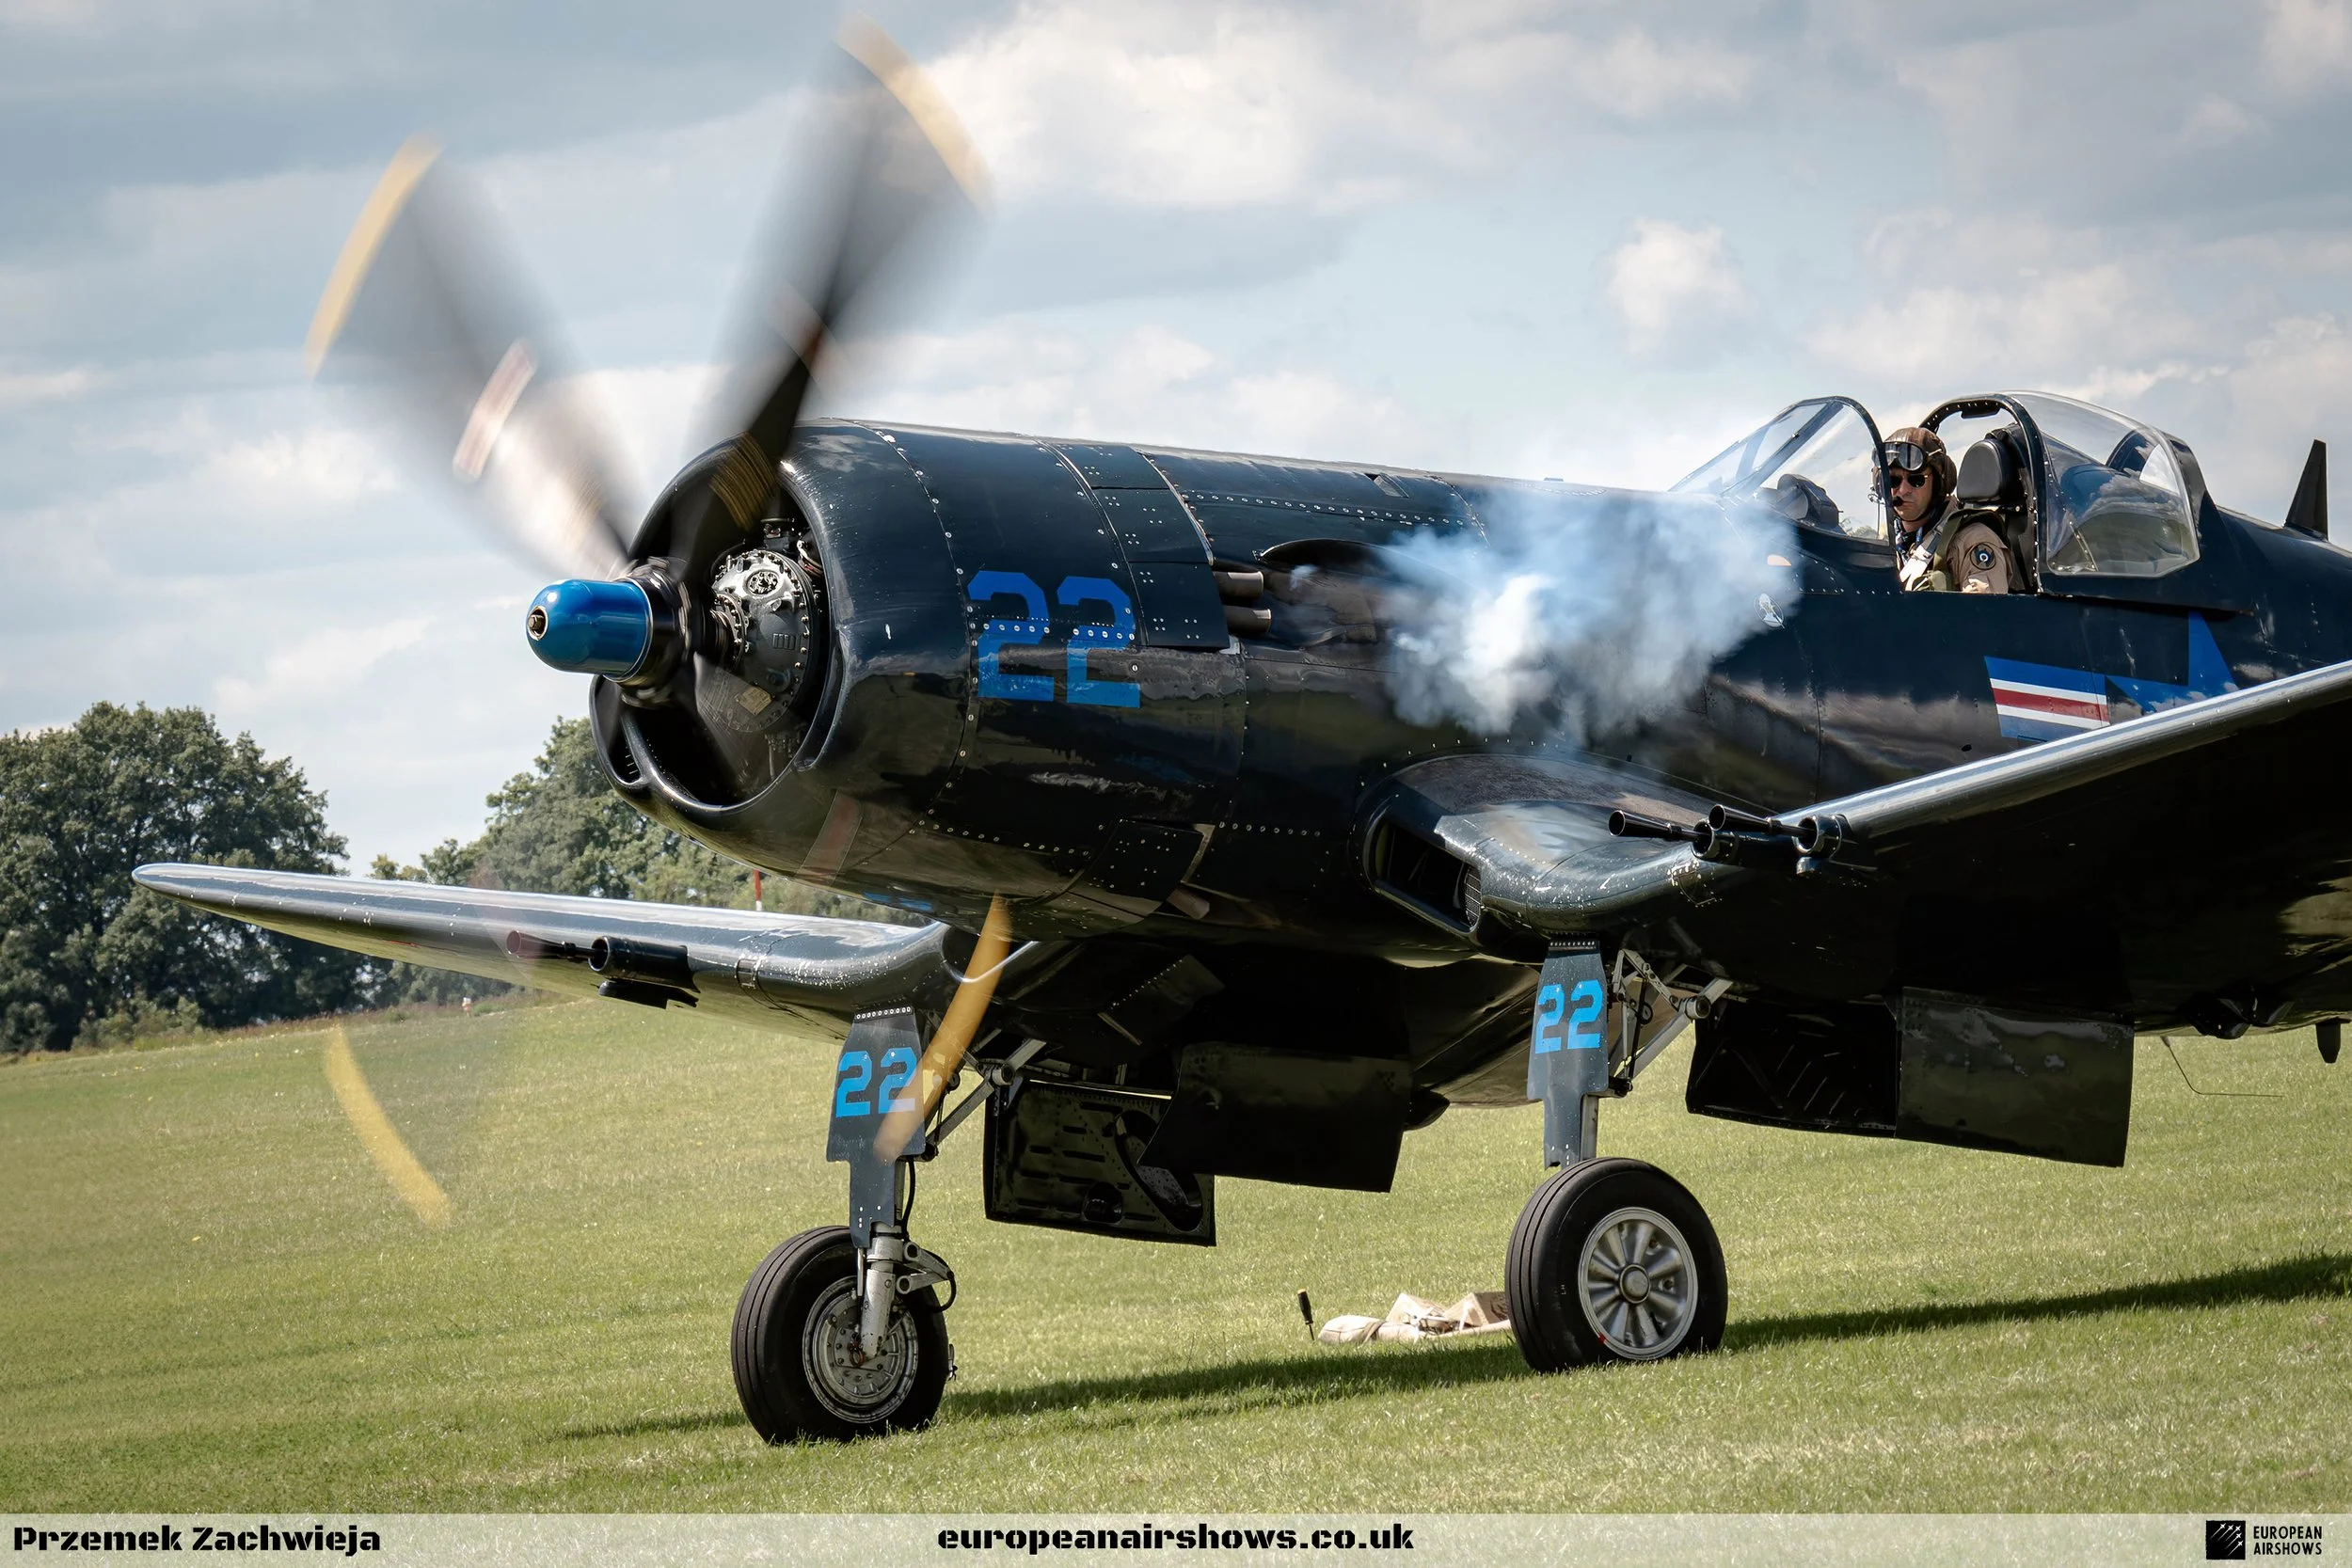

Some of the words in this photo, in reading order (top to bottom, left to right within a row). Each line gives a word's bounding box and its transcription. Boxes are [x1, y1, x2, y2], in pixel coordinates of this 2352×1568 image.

[967, 570, 1141, 708] 22
[1535, 979, 1604, 1054] 22
[835, 1047, 917, 1118] 22
